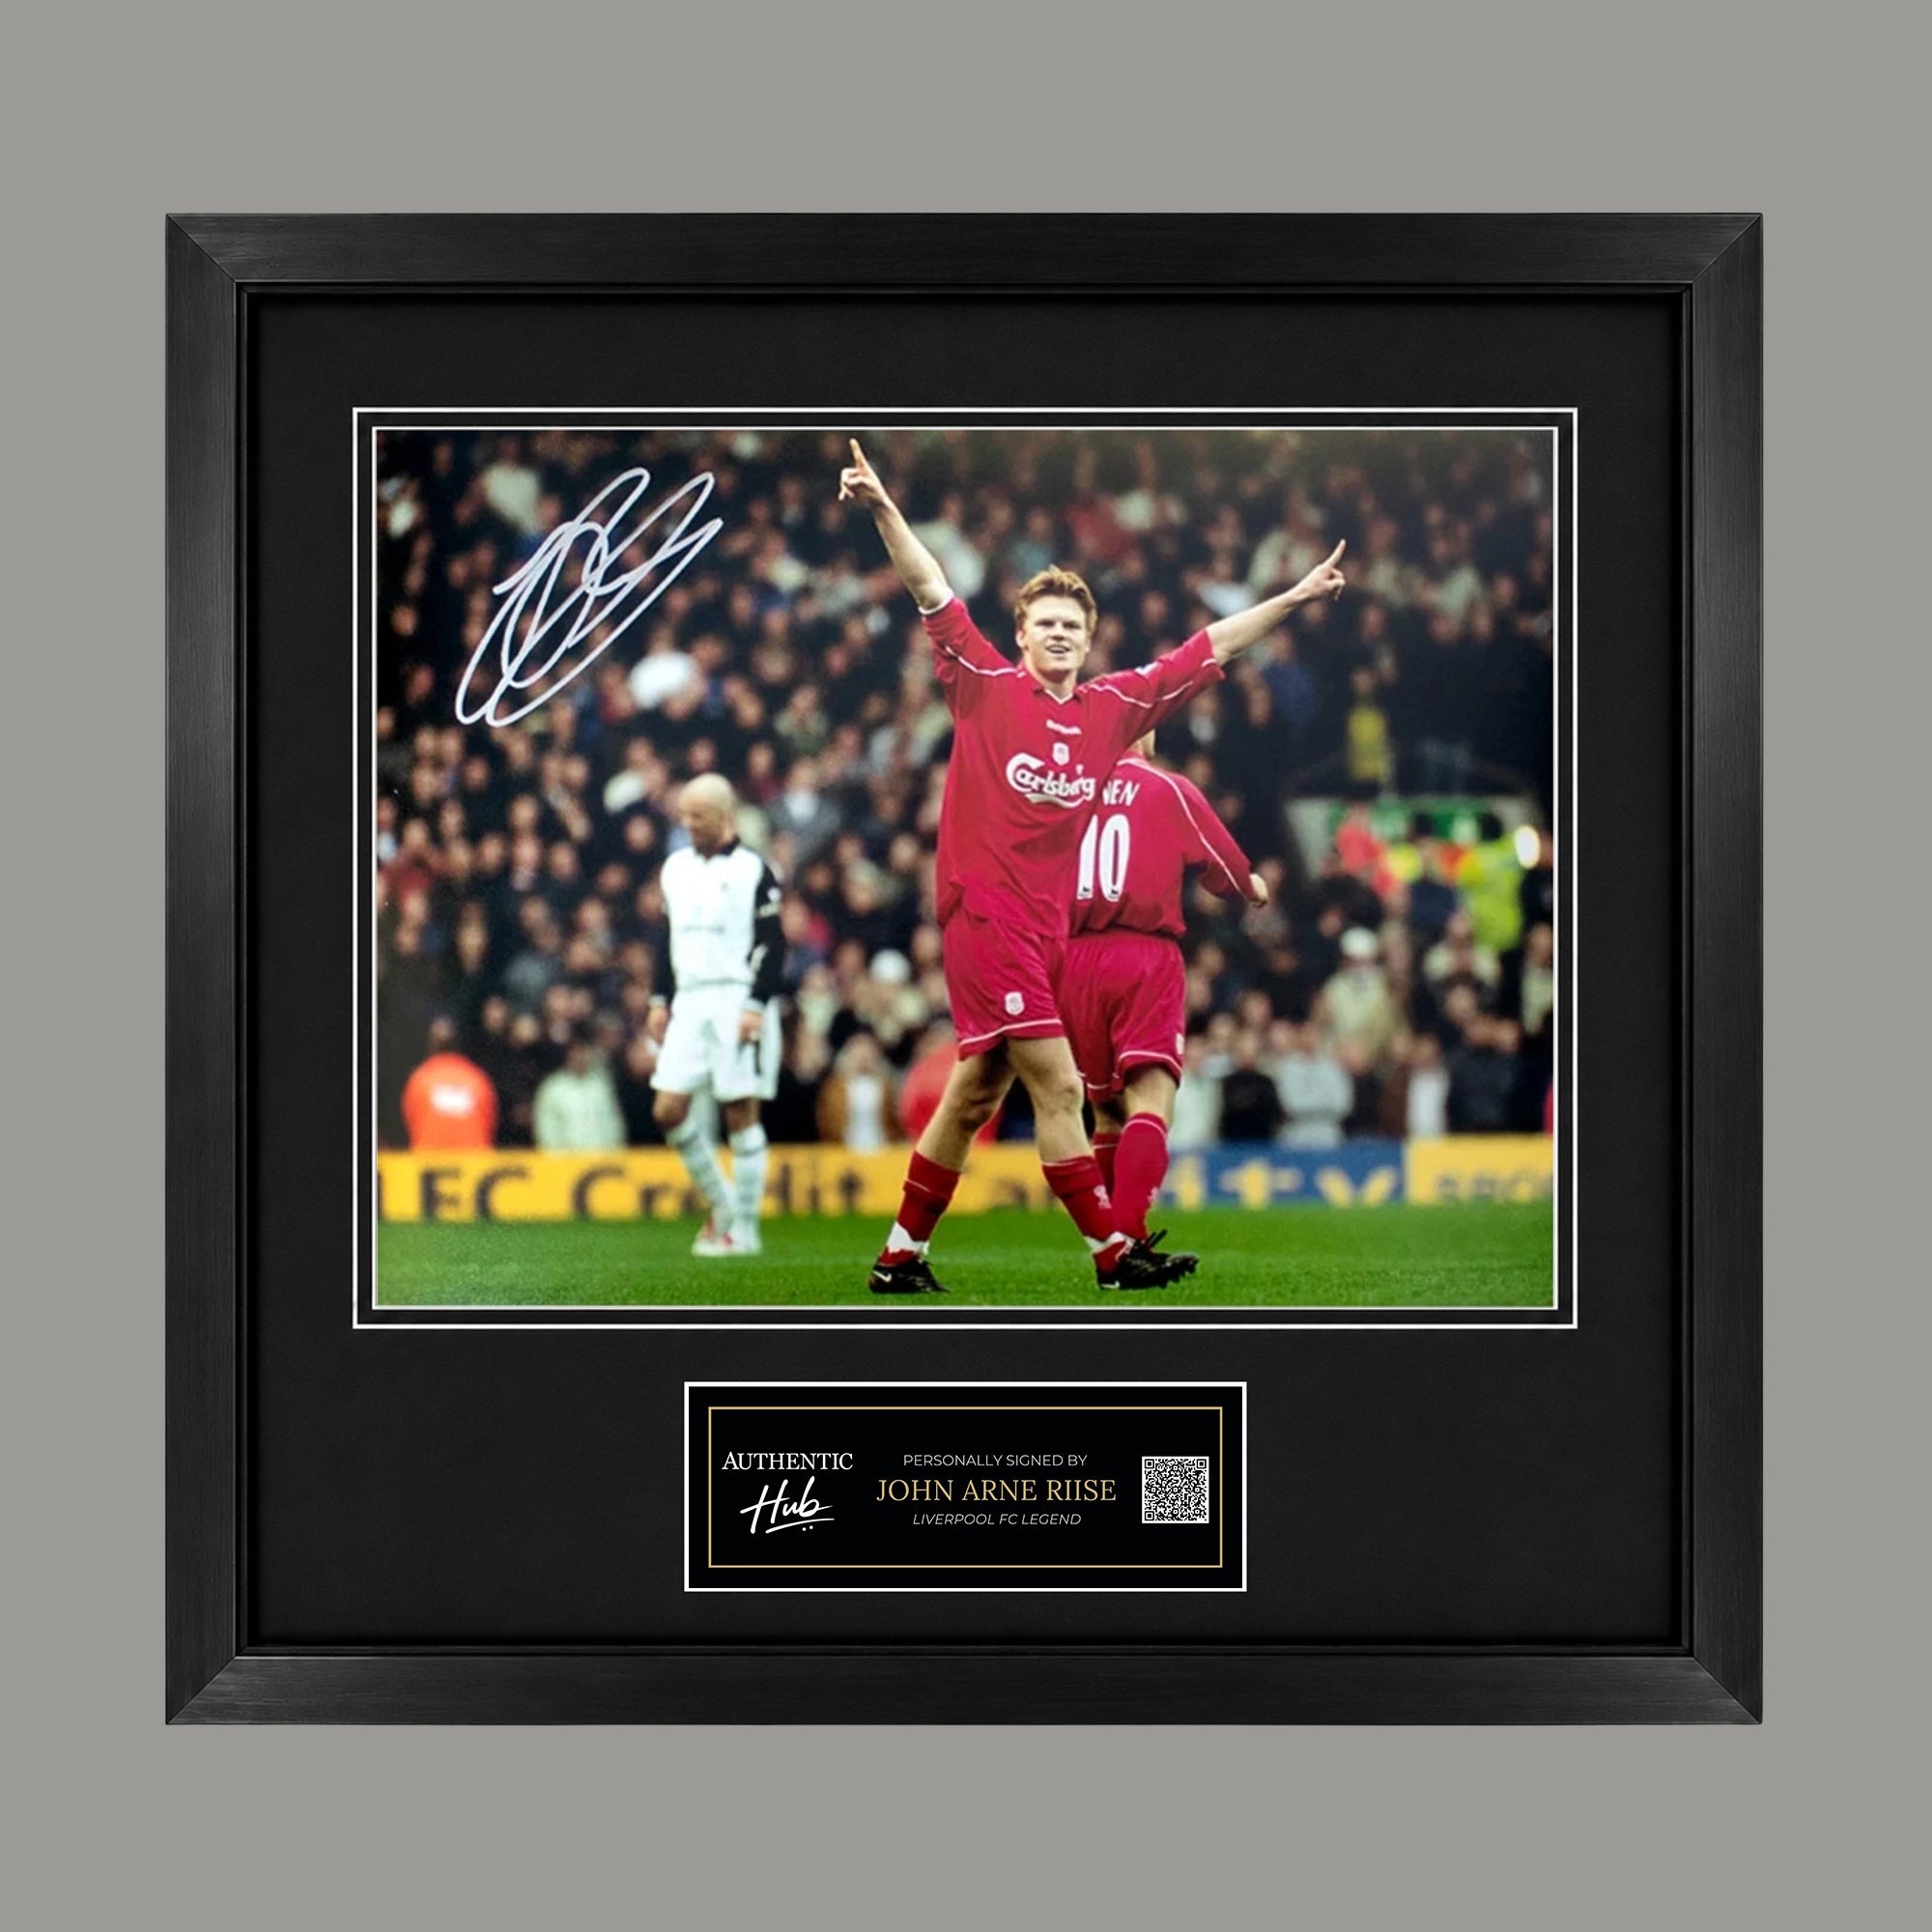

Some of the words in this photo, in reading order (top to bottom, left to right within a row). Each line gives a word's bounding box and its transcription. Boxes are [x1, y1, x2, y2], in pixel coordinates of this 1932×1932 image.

[1076, 813, 1130, 902] 10
[721, 1451, 854, 1470] AUTHENTIC
[903, 1454, 1004, 1466] PERSONALLY
[1006, 1454, 1064, 1466] SIGNED
[1067, 1454, 1088, 1466] BY
[875, 1479, 953, 1502] JOHN
[961, 1479, 1037, 1501] ARNE
[1046, 1479, 1117, 1502] RIISE
[739, 1475, 836, 1534] Hub
[912, 1513, 995, 1525] LIVERPOOL
[999, 1513, 1018, 1525] FC
[1021, 1513, 1082, 1525] LEGEND
